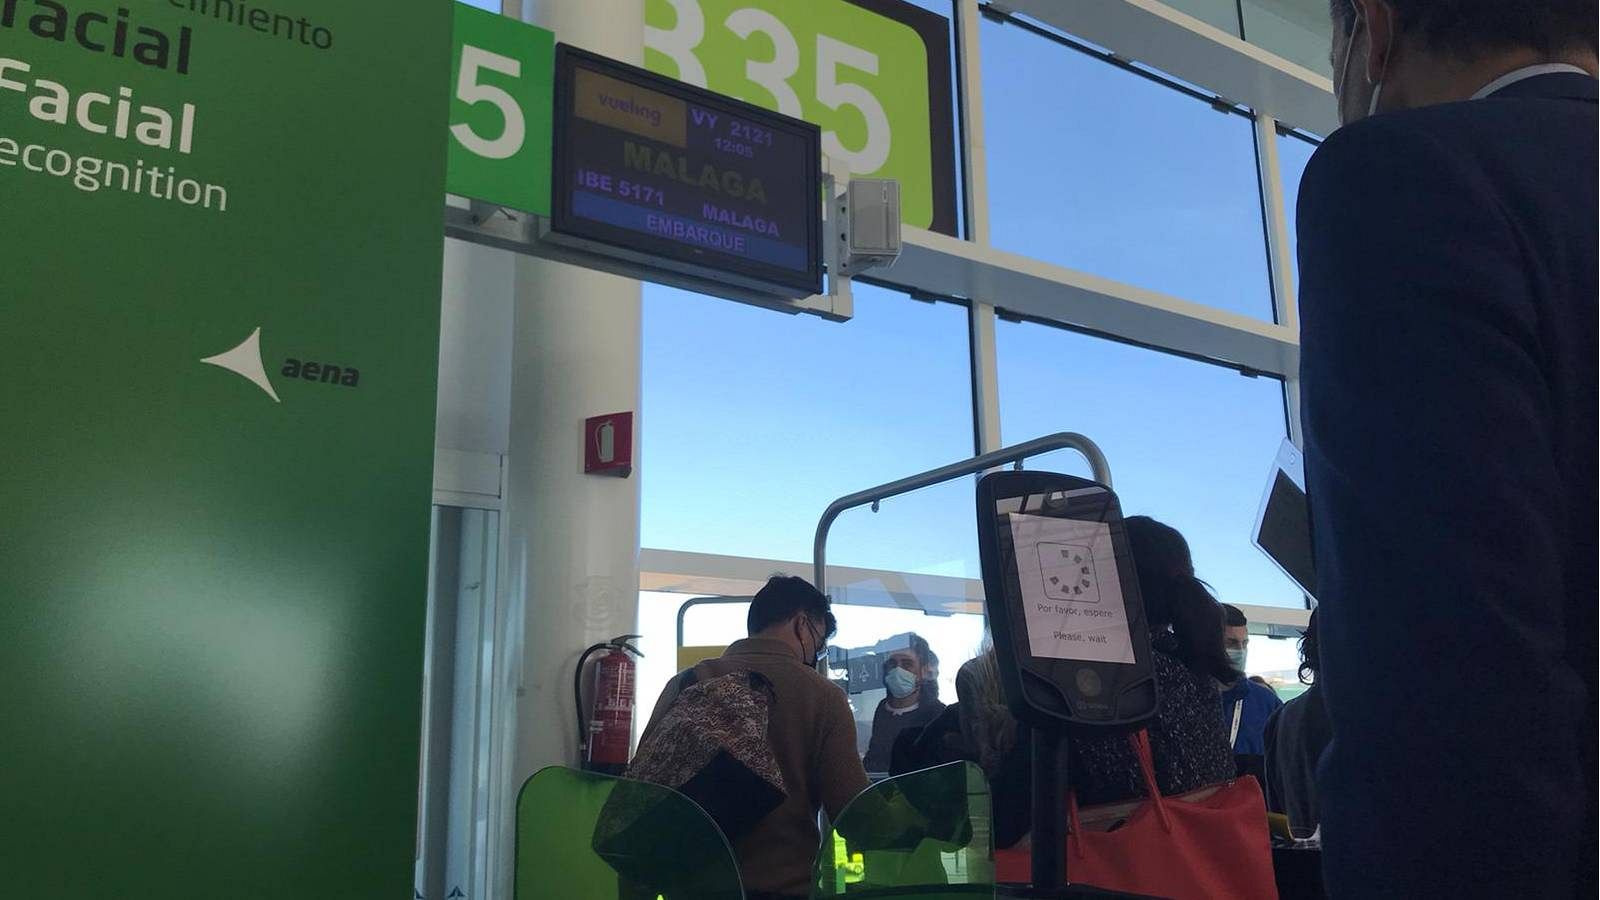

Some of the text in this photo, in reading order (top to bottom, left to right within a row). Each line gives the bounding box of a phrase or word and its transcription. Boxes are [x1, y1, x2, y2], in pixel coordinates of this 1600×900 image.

[0, 57, 196, 154] Facial
[448, 44, 526, 160] 5
[599, 94, 662, 128] vueling
[691, 108, 774, 146] VY 2121
[714, 138, 753, 159] 12:05
[0, 137, 228, 211] ecognition
[577, 168, 665, 206] IBE 5171
[623, 140, 767, 204] MALAGA
[647, 215, 745, 251] EMBARQUE
[703, 203, 780, 237] MALAGA
[281, 358, 360, 387] aena
[1037, 603, 1113, 618] Por favor, espere
[1087, 632, 1108, 644] wait
